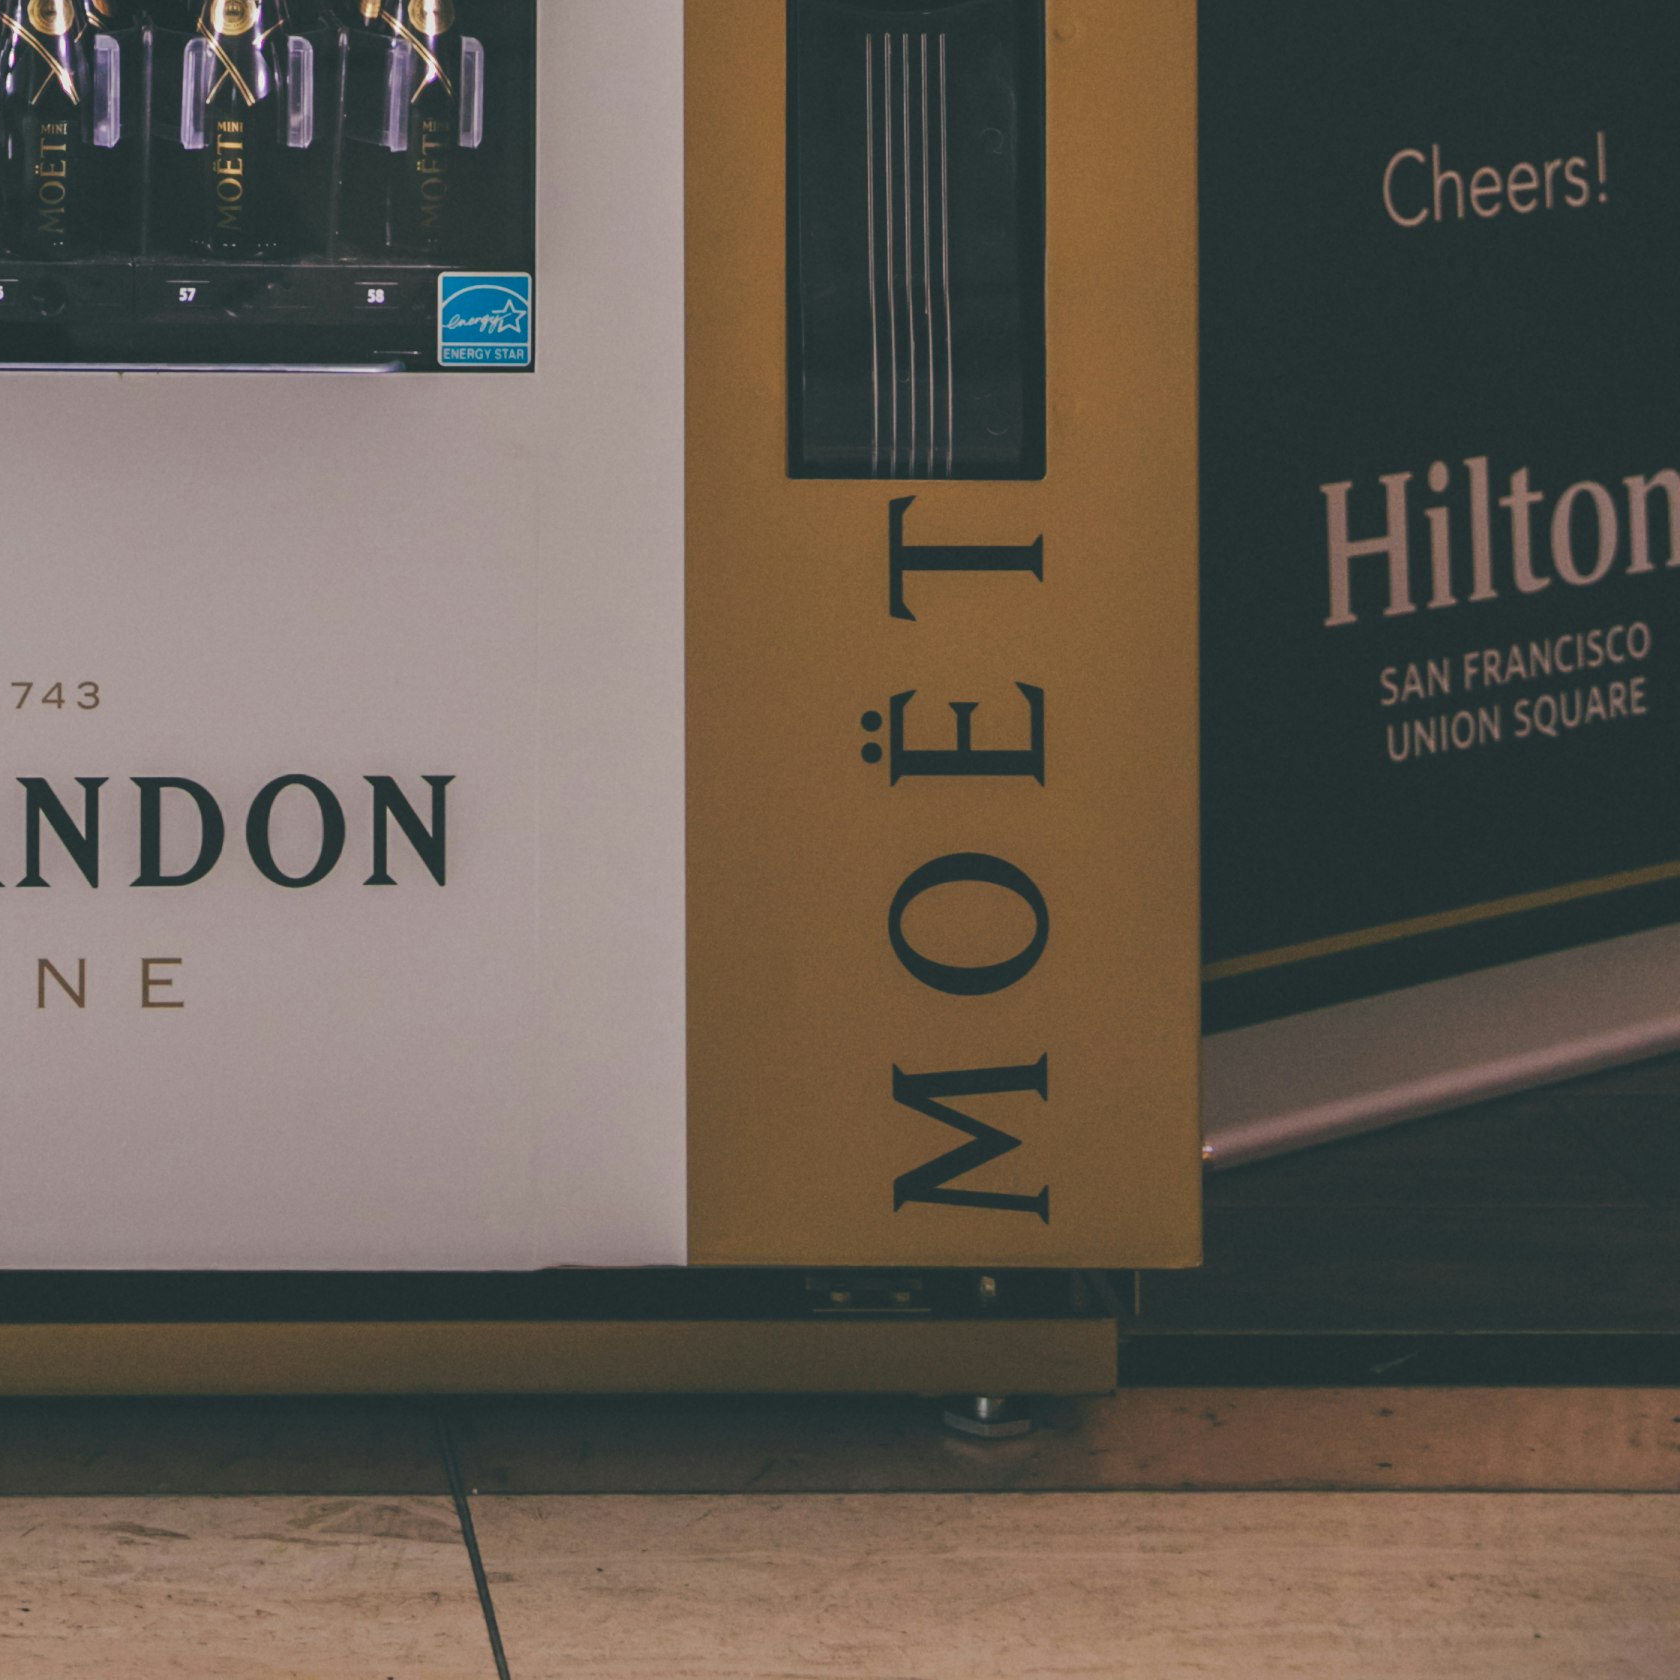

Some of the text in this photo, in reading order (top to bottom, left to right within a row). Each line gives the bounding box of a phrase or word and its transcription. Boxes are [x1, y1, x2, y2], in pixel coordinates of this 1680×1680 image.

[217, 120, 244, 133] MINI
[1381, 129, 1608, 228] Cheers!
[178, 287, 196, 303] 57
[367, 288, 385, 304] 58
[443, 314, 504, 334] energy
[444, 348, 524, 360] ENERGY STAR
[1320, 455, 1680, 627] Hilton
[1380, 621, 1652, 706] SAN FRANCISCO
[1386, 676, 1649, 762] UNION SQUARE
[861, 495, 1050, 1224] MOËT
